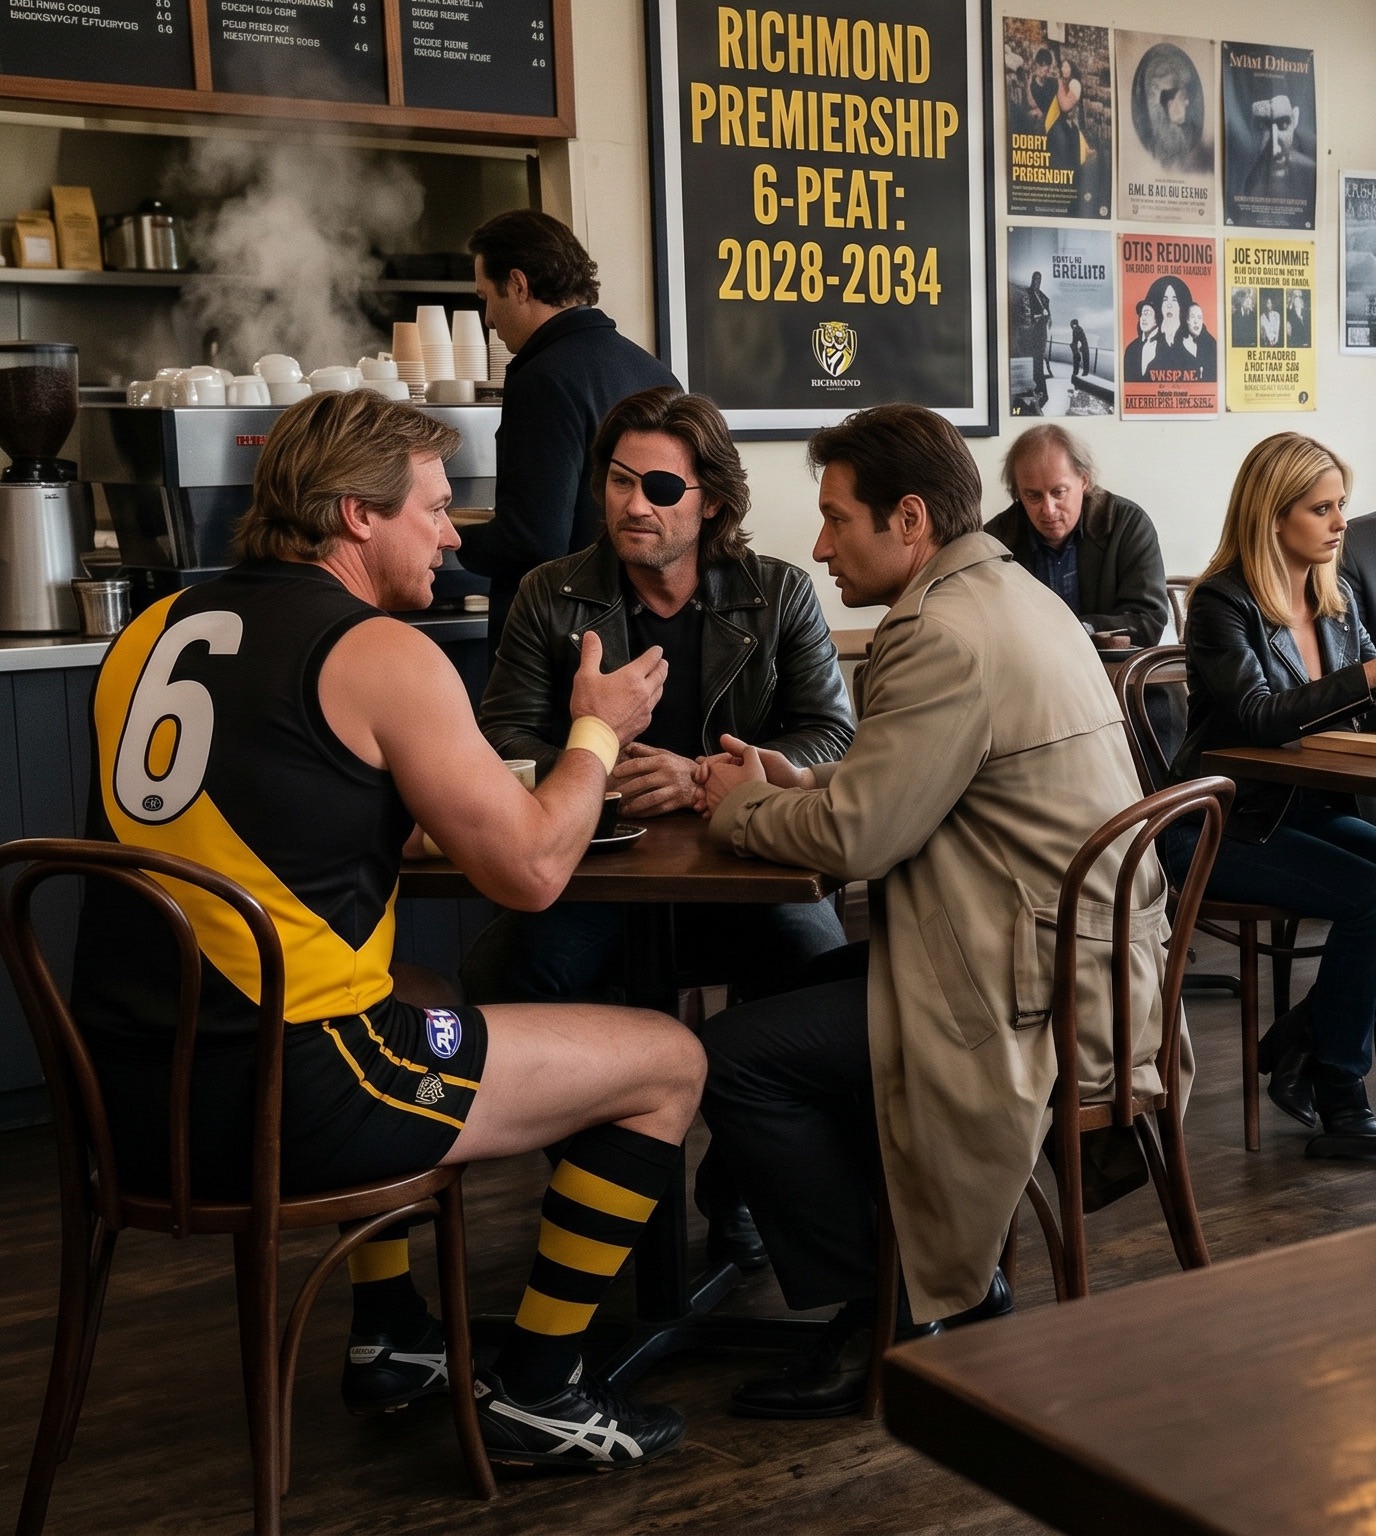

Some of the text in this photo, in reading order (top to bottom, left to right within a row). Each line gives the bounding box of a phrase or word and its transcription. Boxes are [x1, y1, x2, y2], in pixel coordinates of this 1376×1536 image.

[718, 6, 930, 84] RICHMOND
[690, 81, 959, 160] PREMIERSHIP
[753, 164, 905, 231] 6-PEAT:
[718, 238, 942, 306] 2028-2034
[1123, 241, 1213, 264] OTIS REDDING
[1232, 247, 1251, 265] JOE
[116, 610, 244, 822] 6
